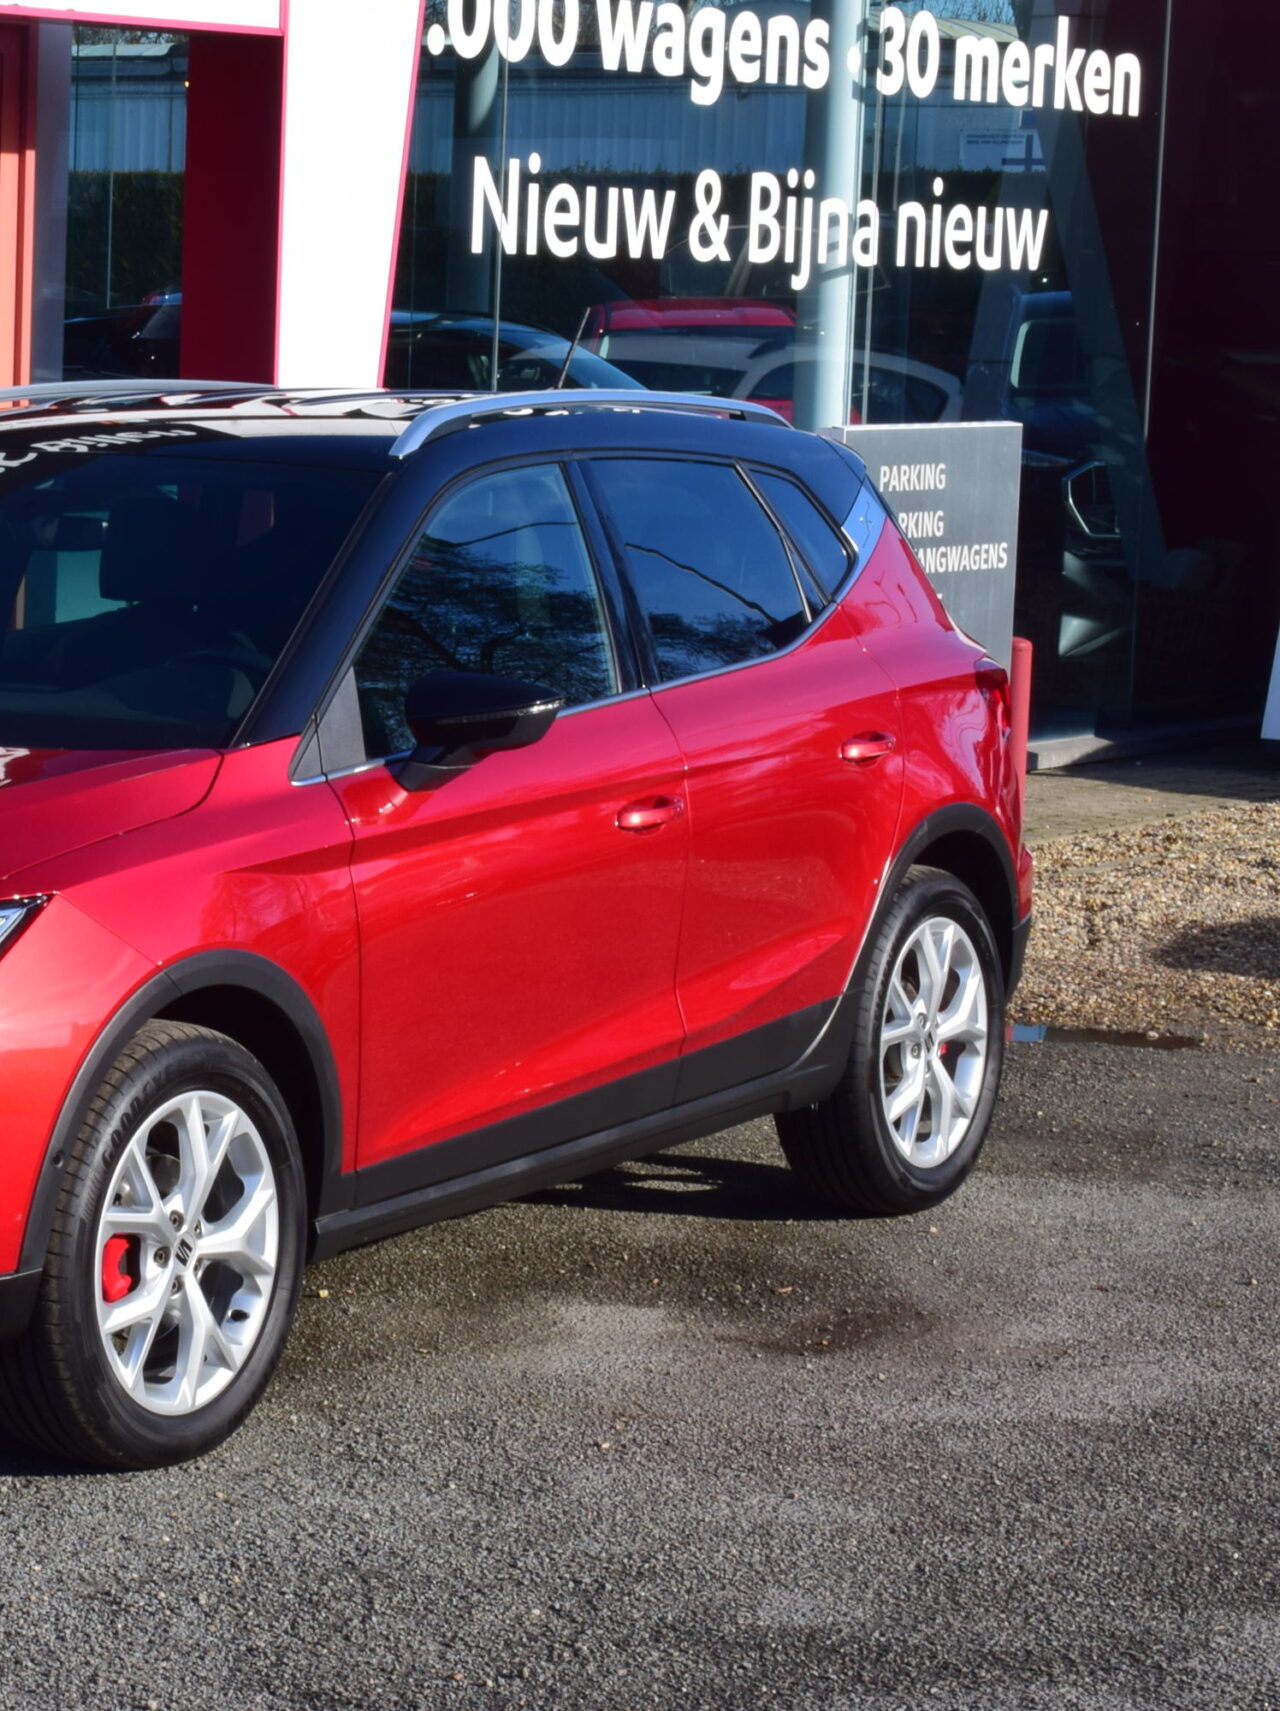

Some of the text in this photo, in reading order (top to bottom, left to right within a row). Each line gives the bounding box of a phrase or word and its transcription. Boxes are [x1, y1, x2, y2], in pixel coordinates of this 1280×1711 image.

[595, 0, 830, 106] wagens
[876, 7, 941, 97] 30
[953, 15, 1143, 117] merken
[470, 152, 1049, 291] Nieuw & Bijna nieuw
[879, 463, 947, 492] PARKING
[898, 509, 944, 539] RKING
[917, 541, 1009, 574] ANGWAGENS
